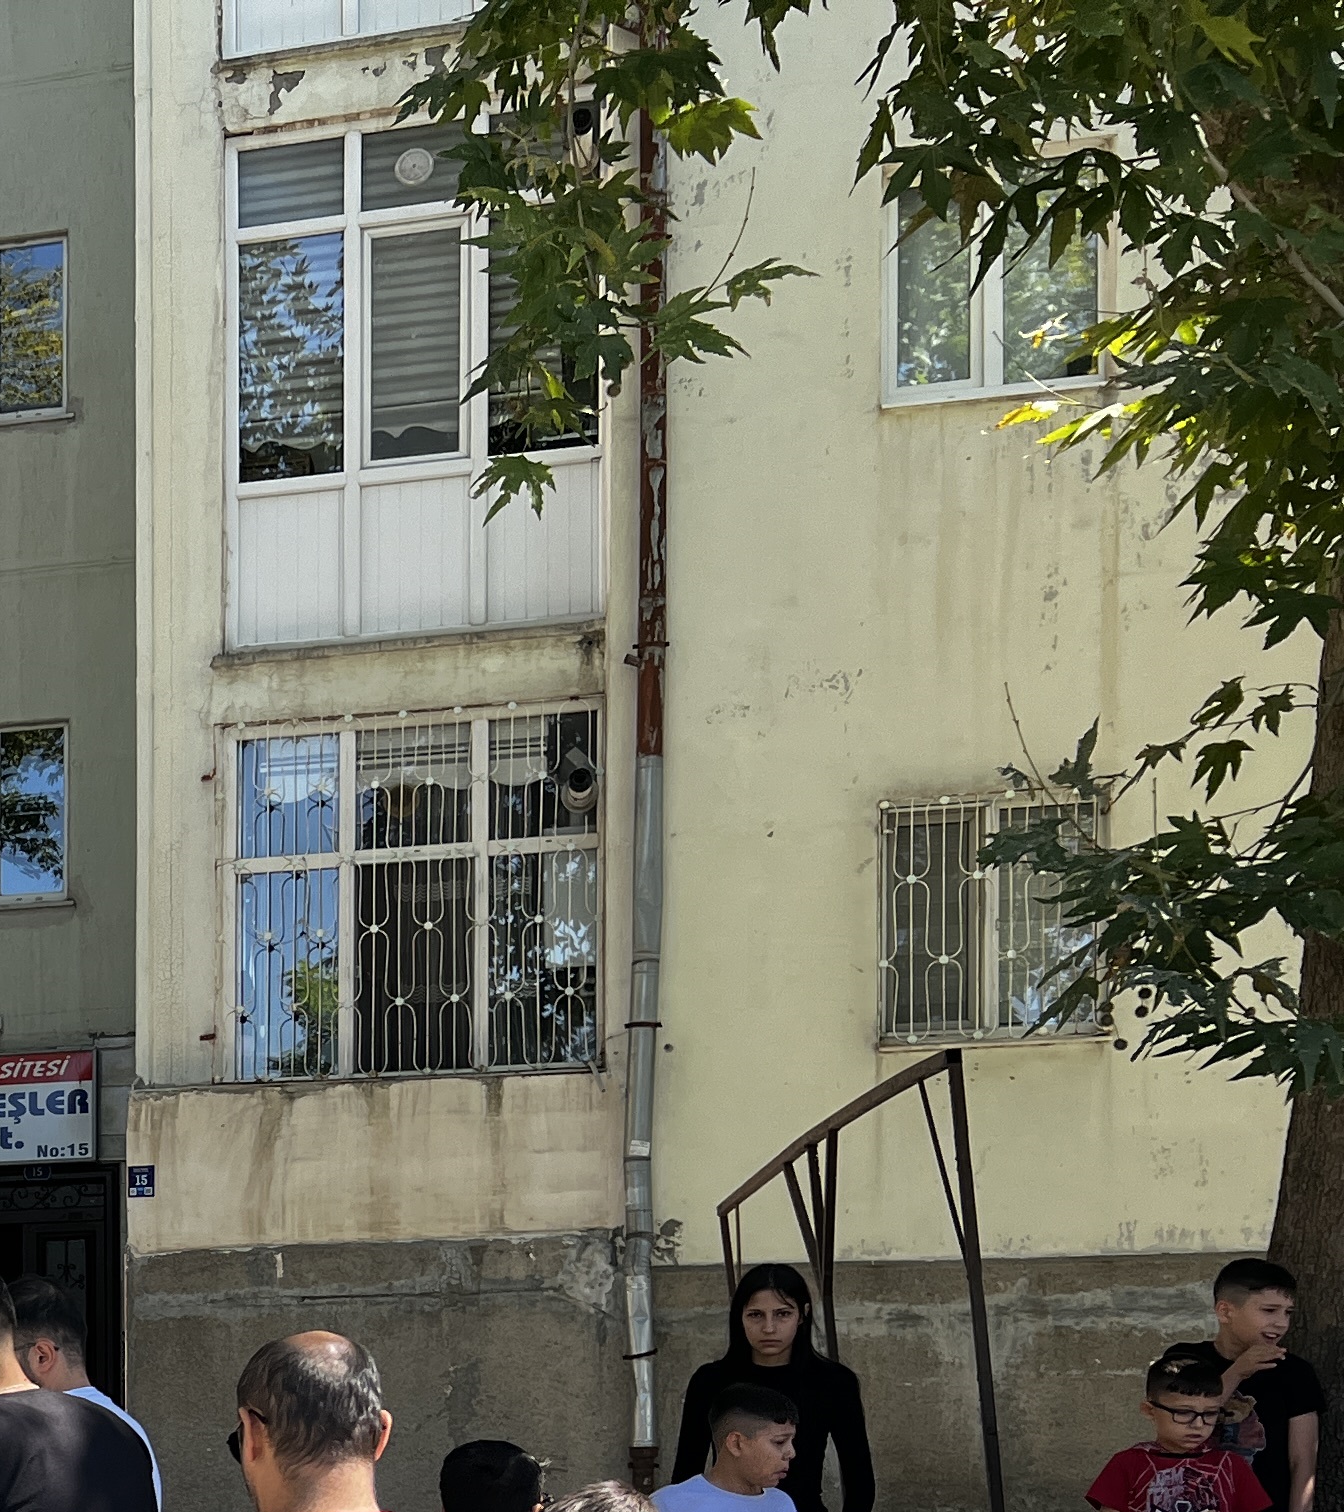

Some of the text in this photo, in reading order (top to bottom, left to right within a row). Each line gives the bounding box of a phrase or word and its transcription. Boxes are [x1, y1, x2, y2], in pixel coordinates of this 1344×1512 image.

[0, 1055, 72, 1080] SİTESİ
[36, 1142, 89, 1159] No:15
[32, 1166, 43, 1177] 15
[135, 1173, 148, 1186] 15
